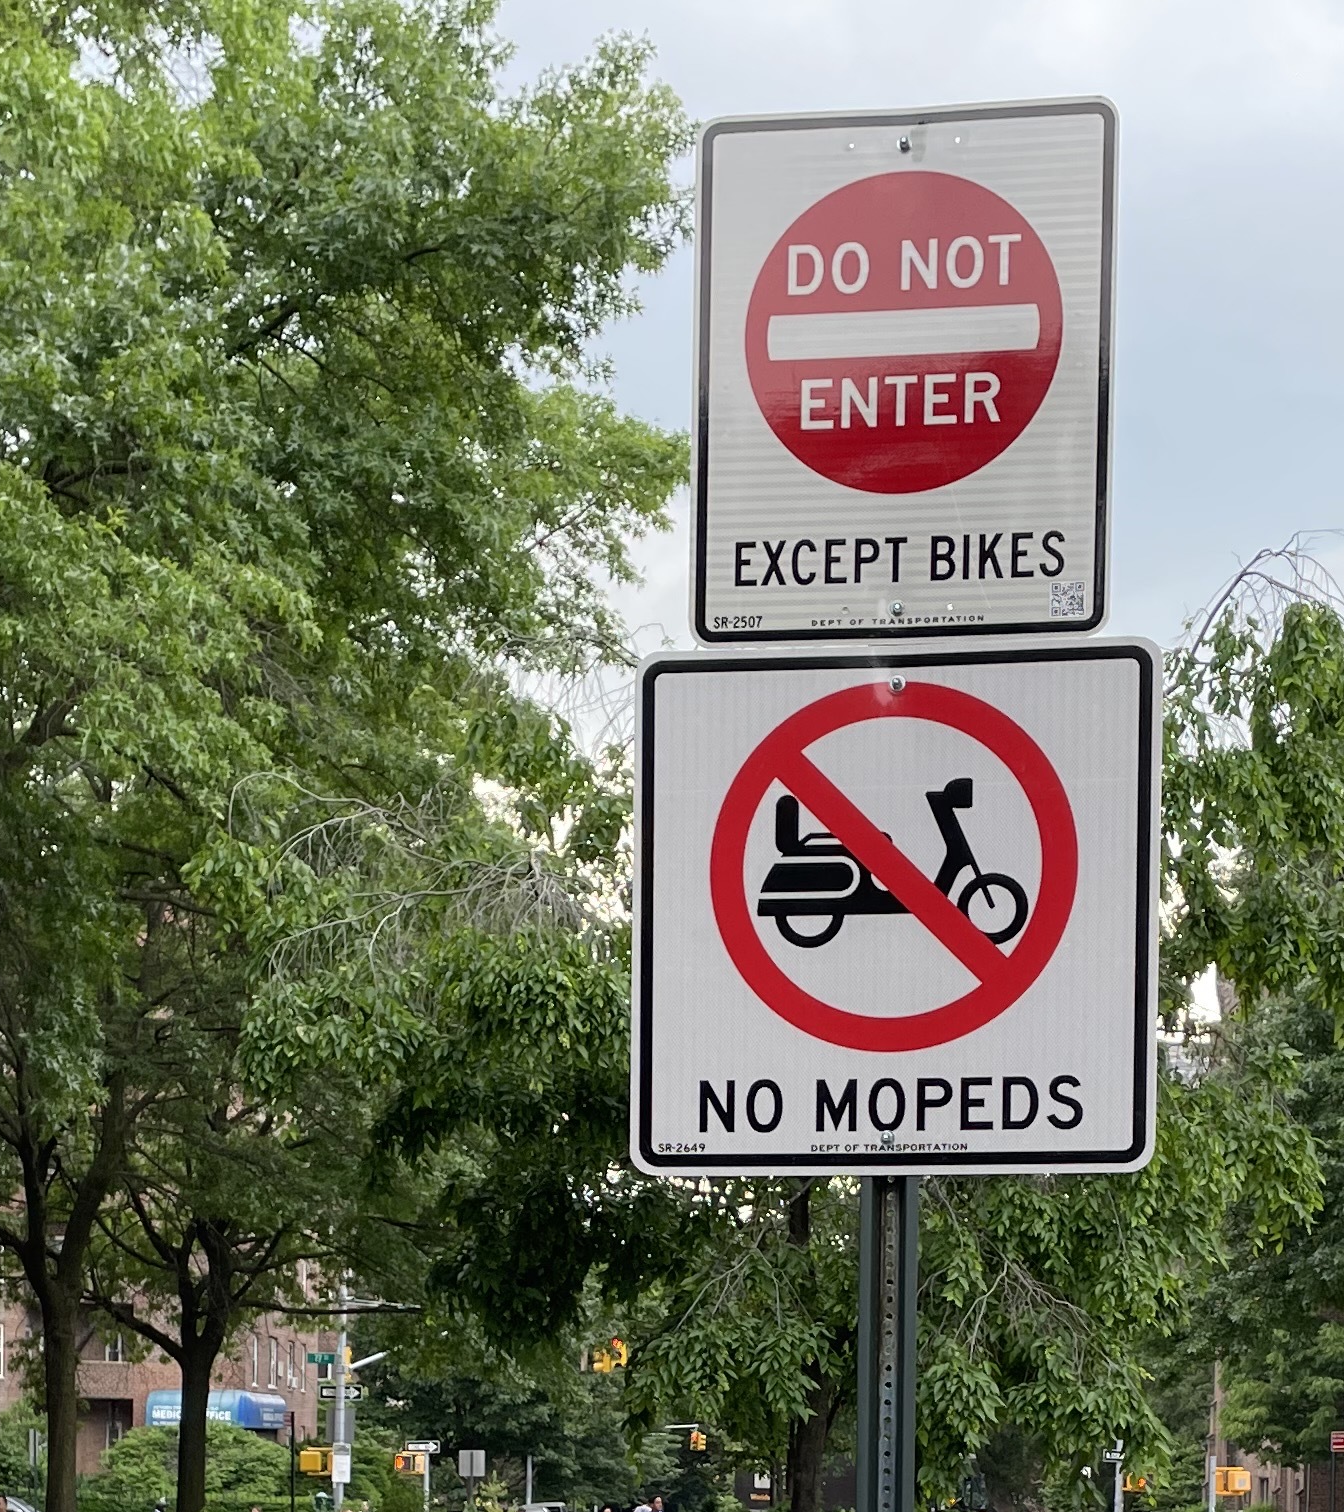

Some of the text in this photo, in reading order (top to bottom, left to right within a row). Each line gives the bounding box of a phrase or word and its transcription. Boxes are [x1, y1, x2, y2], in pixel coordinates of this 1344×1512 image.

[787, 233, 1022, 296] DO NOT
[800, 371, 1002, 431] ENTER
[734, 529, 1066, 587] EXCEPT BIKES
[713, 615, 763, 629] SR-2507
[811, 614, 985, 627] DEPT OF TRANSPORTATION
[698, 1074, 1084, 1134] NO MOPEDS
[658, 1142, 706, 1153] SR-2649
[810, 1142, 969, 1152] DEPT OF TRANSPORTATION
